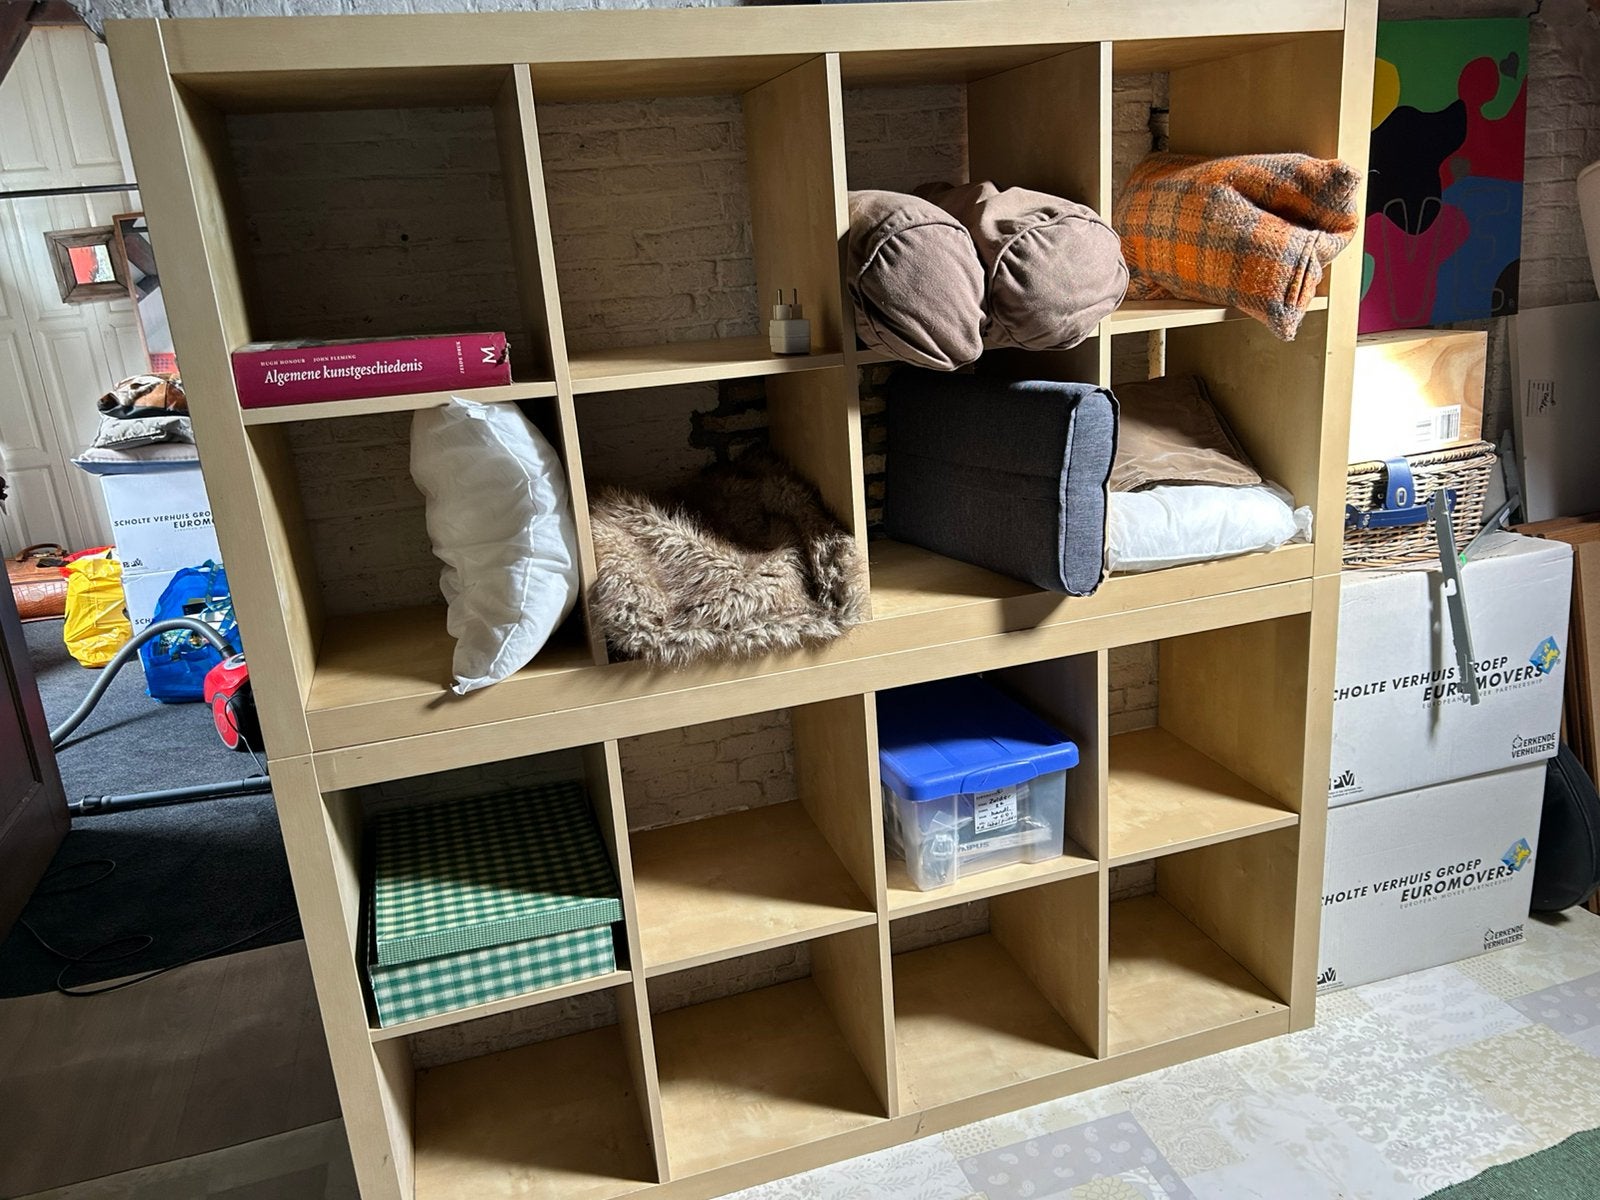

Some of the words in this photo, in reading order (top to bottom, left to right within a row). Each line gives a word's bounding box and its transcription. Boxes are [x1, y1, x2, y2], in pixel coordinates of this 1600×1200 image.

[480, 347, 497, 363] M
[264, 369, 321, 386] Algemene
[322, 358, 423, 380] kunstgeschiedenis
[114, 517, 151, 527] SCHOLTE
[153, 513, 190, 523] VERHUIS
[173, 518, 214, 529] EUROM
[1392, 667, 1455, 690] VERHUIS
[1473, 656, 1508, 673] ROEP
[1423, 663, 1543, 702] EURMOVERS
[1495, 679, 1543, 693] PARTNERSHIP
[1523, 732, 1556, 748] ERKENDE
[1511, 742, 1555, 758] VERHUIZERS
[1373, 871, 1431, 893] VERHUIS
[1436, 858, 1482, 878] GROEP
[1400, 863, 1516, 902] EUROMOVERS
[1400, 896, 1437, 909] EUROPEAN
[1468, 877, 1514, 892] PARTNERSHIP
[1494, 924, 1524, 939] ERKENDE
[1483, 932, 1523, 950] VERHUIZERS
